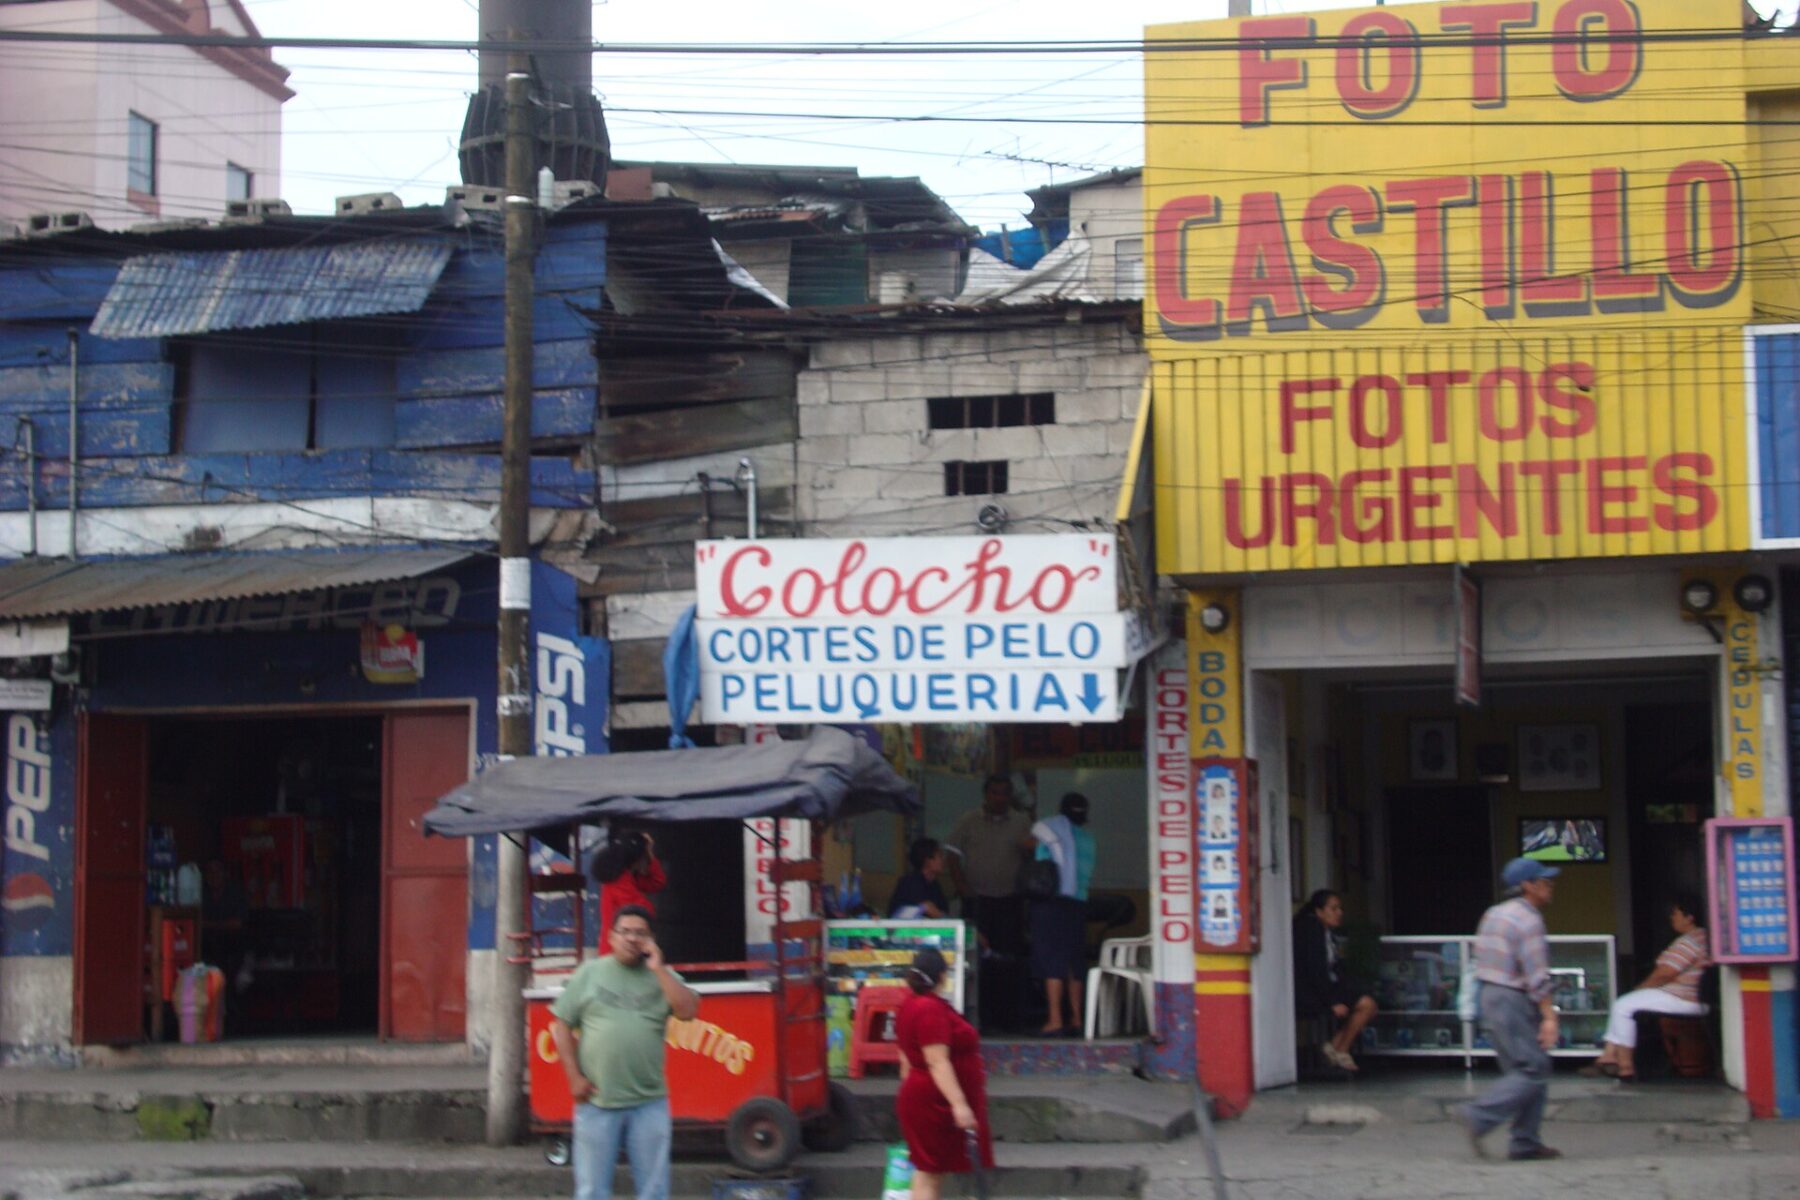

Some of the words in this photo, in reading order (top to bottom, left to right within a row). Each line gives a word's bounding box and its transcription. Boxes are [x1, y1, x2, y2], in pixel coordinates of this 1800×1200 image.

[1238, 0, 1643, 129] FOTO
[1153, 158, 1743, 342] CASTILLO
[1279, 361, 1597, 454] FOTOS
[1223, 452, 1719, 550] URGENTES
[708, 623, 880, 664] CORTES
[893, 624, 946, 661] DE
[964, 621, 1101, 660] PELO
[720, 671, 1071, 720] PELUQUERIA
[1157, 668, 1188, 793] CORTES
[1199, 651, 1227, 759] BODA
[1730, 622, 1757, 780] CEDULAS
[1158, 800, 1189, 839] DE
[1158, 850, 1191, 943] PELO
